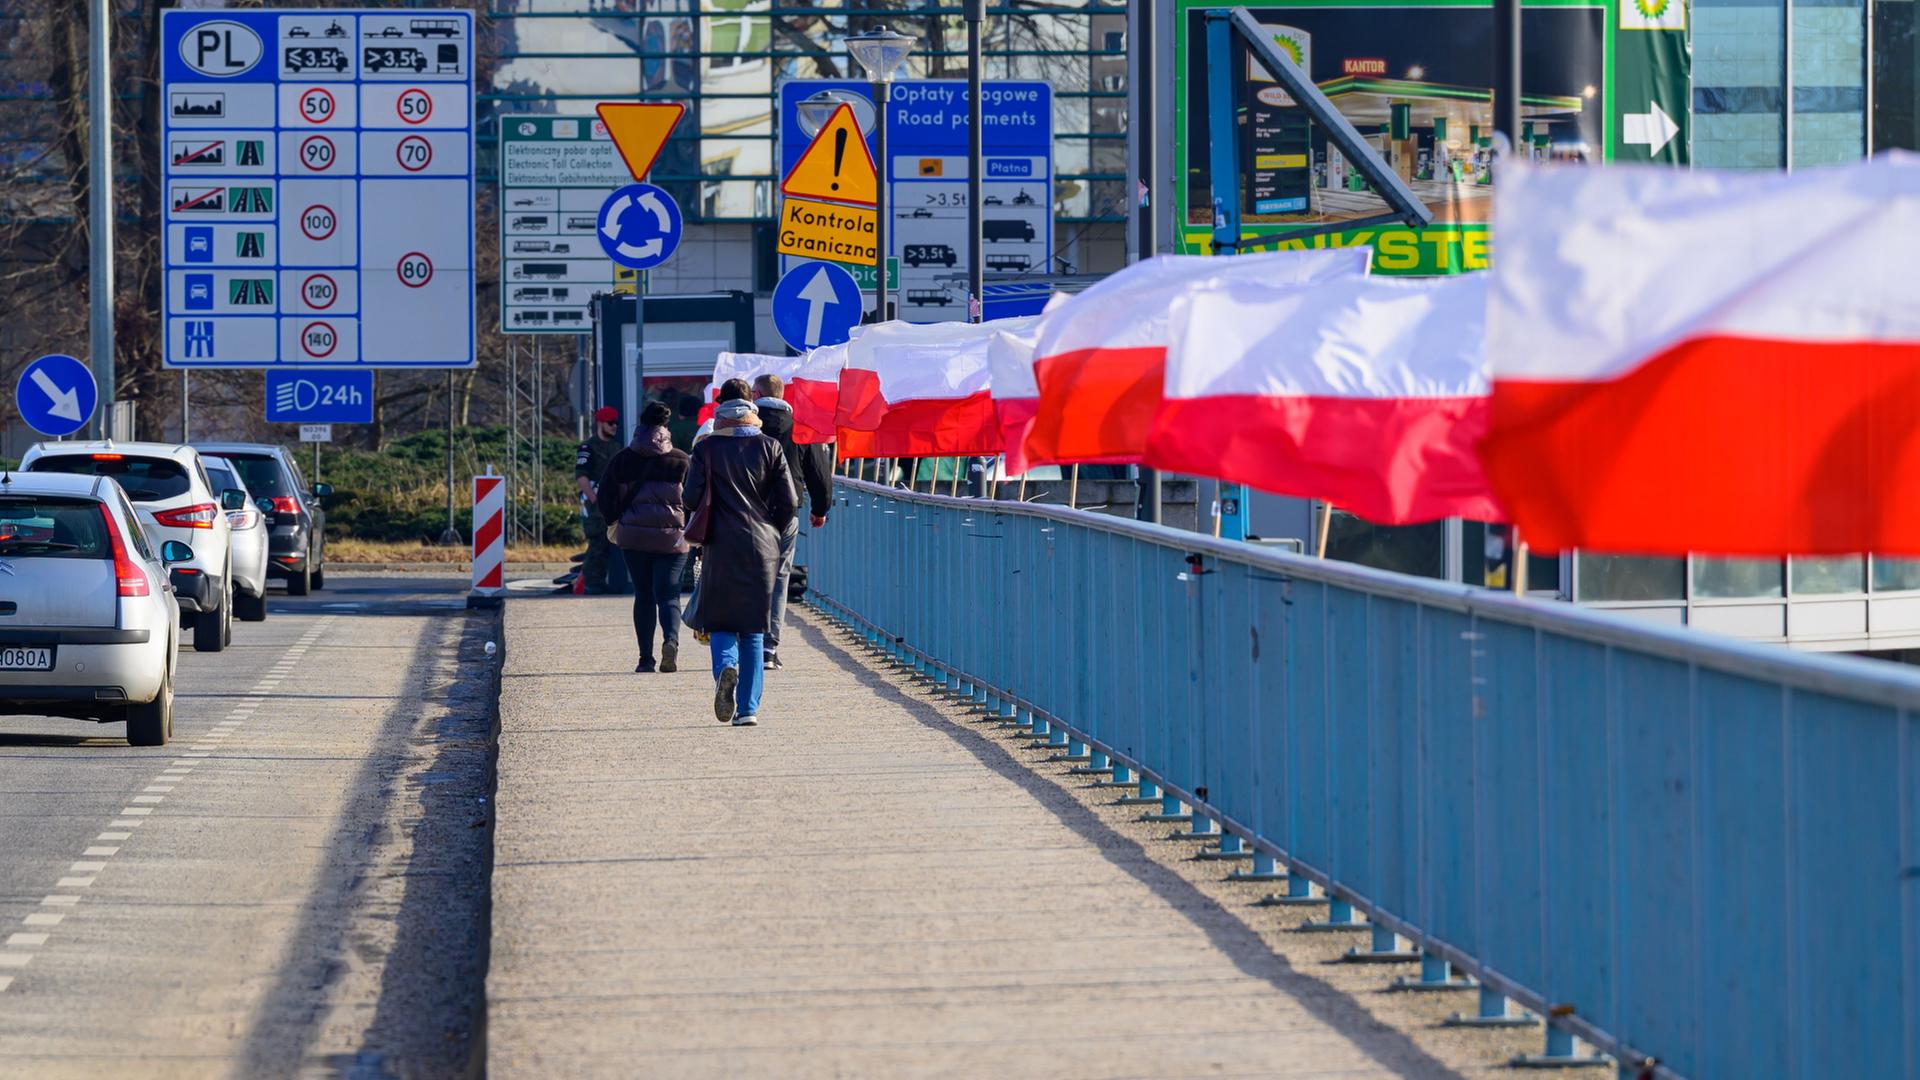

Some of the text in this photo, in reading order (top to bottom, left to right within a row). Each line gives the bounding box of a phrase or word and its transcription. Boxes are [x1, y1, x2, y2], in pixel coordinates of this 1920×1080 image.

[197, 30, 245, 67] PL
[1345, 60, 1385, 73] KANTOR
[893, 85, 1038, 106] Opłaty ogowe
[305, 97, 331, 114] 50
[403, 97, 428, 115] 50
[898, 110, 1036, 129] Road pments
[522, 125, 532, 134] PL
[306, 145, 331, 162] 90
[405, 145, 427, 162] 70
[508, 145, 560, 157] Elektroniczny
[508, 159, 613, 169] Electronic Toll Collection
[991, 162, 1028, 173] Płatna
[306, 215, 332, 230] 100
[790, 206, 874, 233] Kontrola
[781, 230, 876, 258] Graniczna
[403, 261, 428, 279] 80
[308, 285, 332, 299] 120
[307, 332, 332, 347] 140
[321, 385, 363, 405] 24h
[0, 650, 47, 666] 080A
